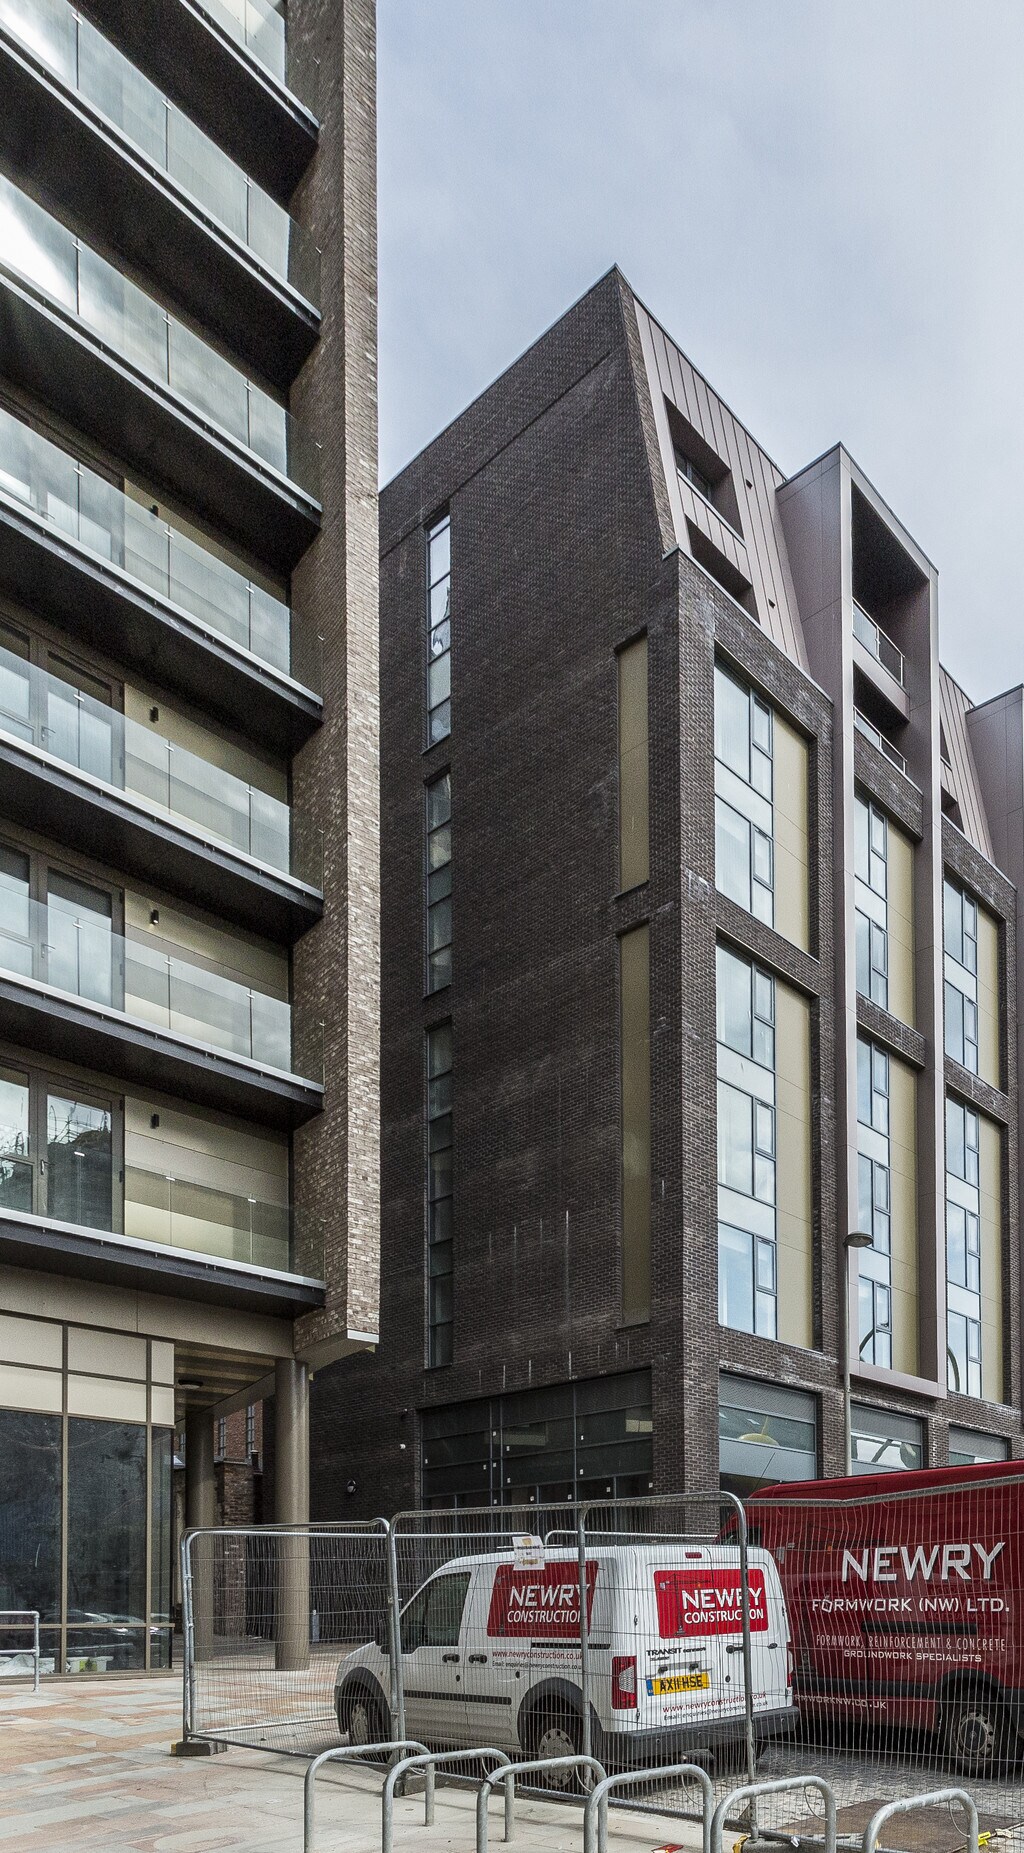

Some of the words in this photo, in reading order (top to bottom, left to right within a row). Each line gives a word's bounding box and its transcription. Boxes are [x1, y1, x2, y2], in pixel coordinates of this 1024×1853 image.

[842, 1542, 1006, 1582] NEWRY
[812, 1597, 912, 1613] FORMWORK
[919, 1598, 959, 1612] (NW)
[966, 1598, 1010, 1612] LTD.
[507, 1610, 581, 1623] CONSTRUCTIO
[684, 1608, 764, 1624] CONSTRUCON
[646, 1647, 682, 1656] TRANSIT
[868, 1636, 941, 1650] REINFORCEMENT
[957, 1637, 1006, 1652] CONCRETE
[844, 1649, 913, 1660] GROUNDWORK
[916, 1651, 982, 1662] SPECIALISTS
[682, 1675, 704, 1689] HSE
